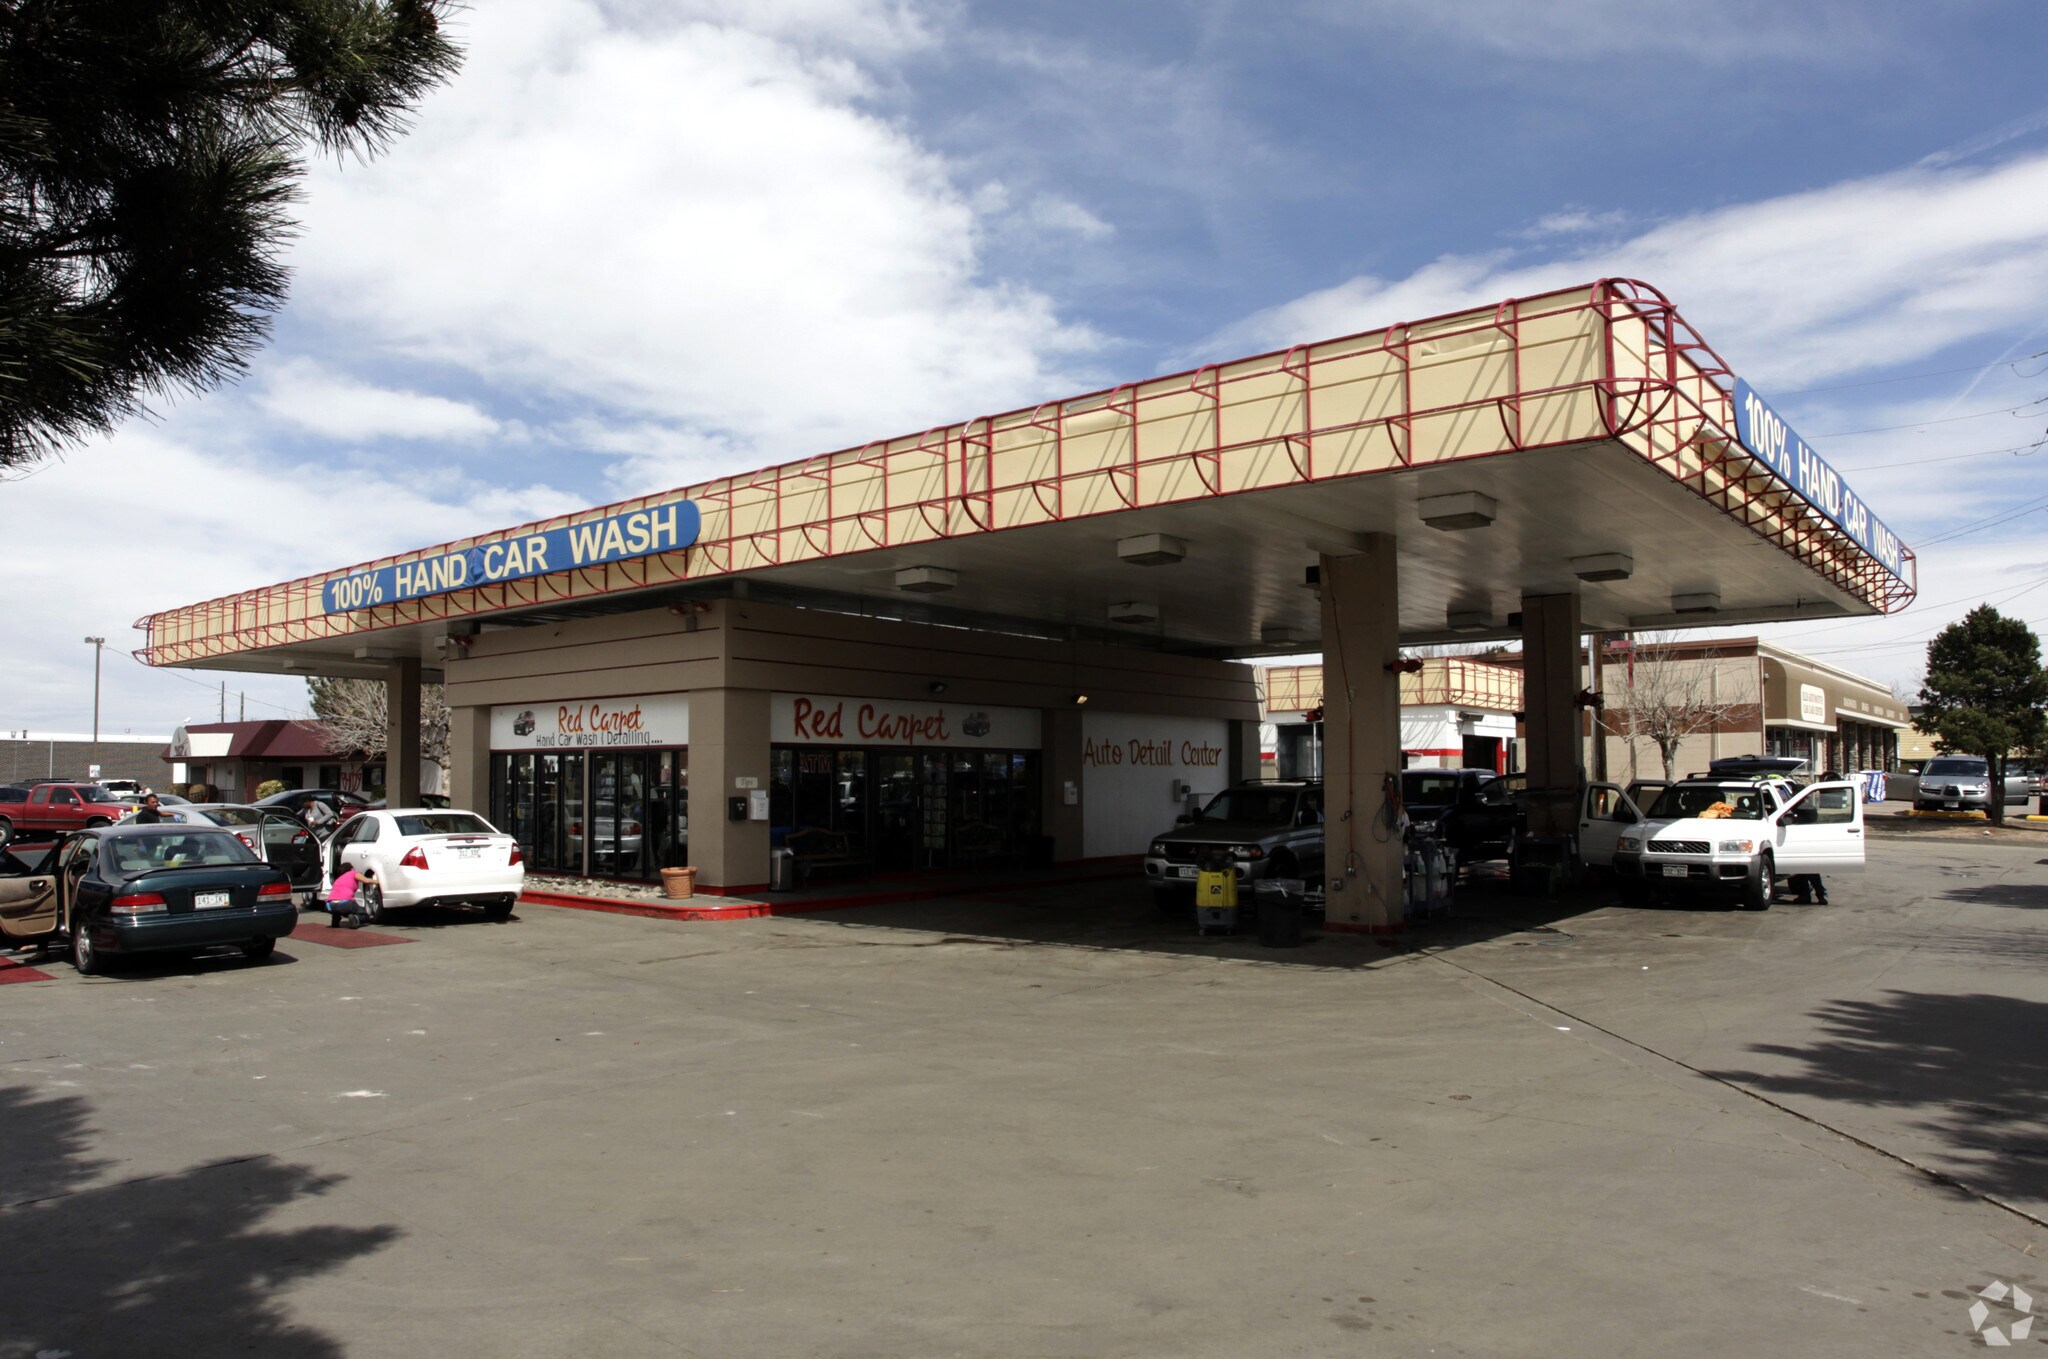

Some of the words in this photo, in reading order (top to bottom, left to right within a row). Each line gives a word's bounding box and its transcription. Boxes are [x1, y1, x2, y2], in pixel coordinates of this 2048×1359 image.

[1745, 391, 1791, 480] 100%
[1797, 440, 1840, 517] HAND
[1844, 490, 1868, 547] CAR
[1872, 516, 1900, 573] WASH
[331, 571, 383, 611] 100%
[395, 553, 468, 599] HAND
[484, 536, 549, 581] CAR
[568, 506, 678, 565] WASH
[558, 704, 584, 733] Red
[590, 703, 644, 735] Carpet
[793, 697, 844, 740] Red
[857, 703, 951, 745] Carpet
[536, 732, 555, 747] Hand
[558, 733, 572, 747] Car
[576, 732, 598, 746] Wash
[1083, 737, 1124, 767] Auto
[1128, 739, 1174, 767] Detail
[1181, 740, 1223, 767] Center
[800, 754, 832, 774] ATM
